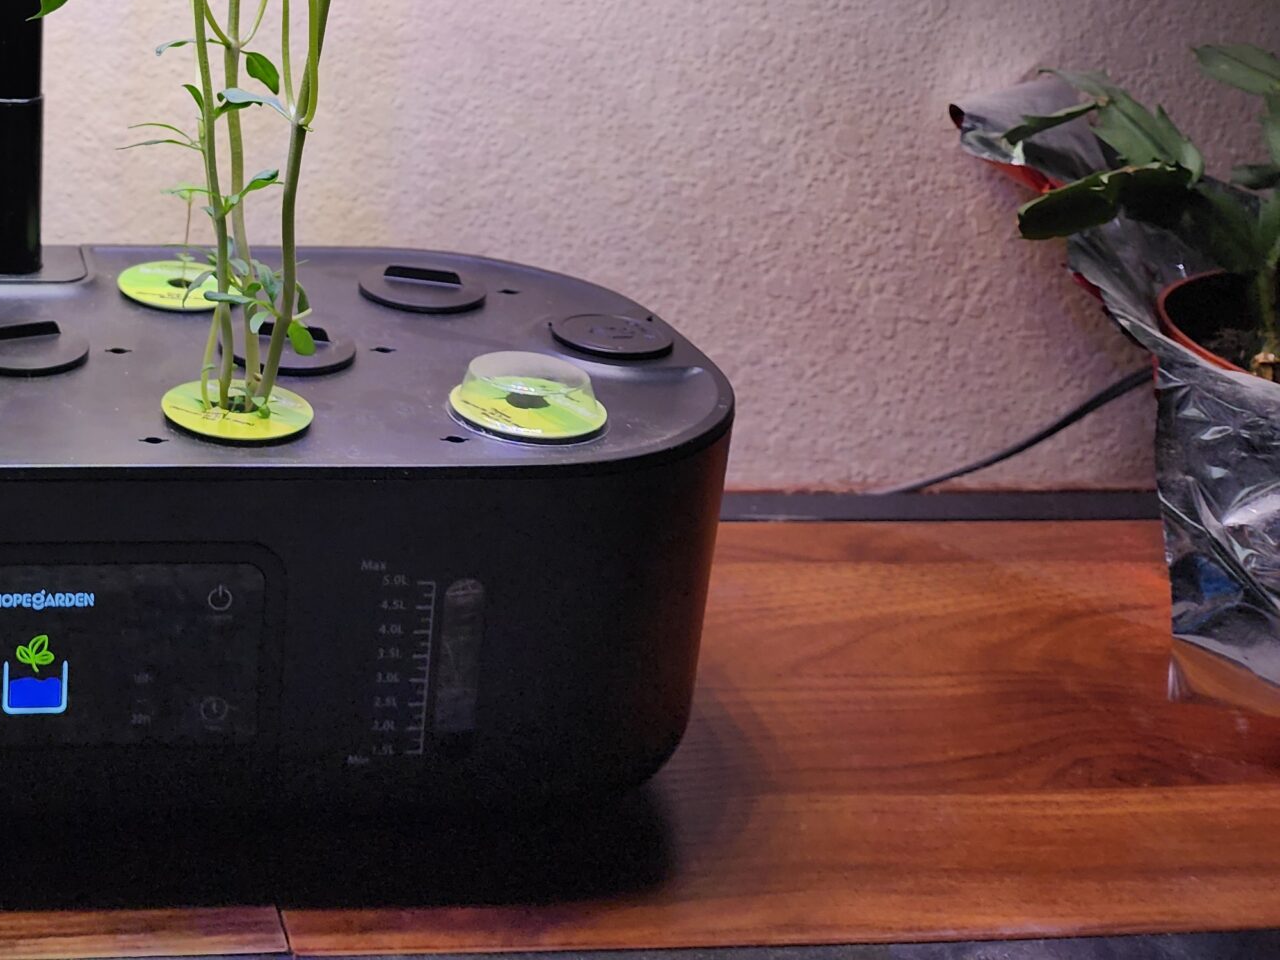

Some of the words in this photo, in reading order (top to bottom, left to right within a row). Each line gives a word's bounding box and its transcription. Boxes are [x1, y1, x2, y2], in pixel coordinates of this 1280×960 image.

[360, 560, 386, 571] Max
[383, 575, 408, 586] 5.0L
[381, 600, 406, 610] 4.5L
[378, 624, 403, 635] 4.0L
